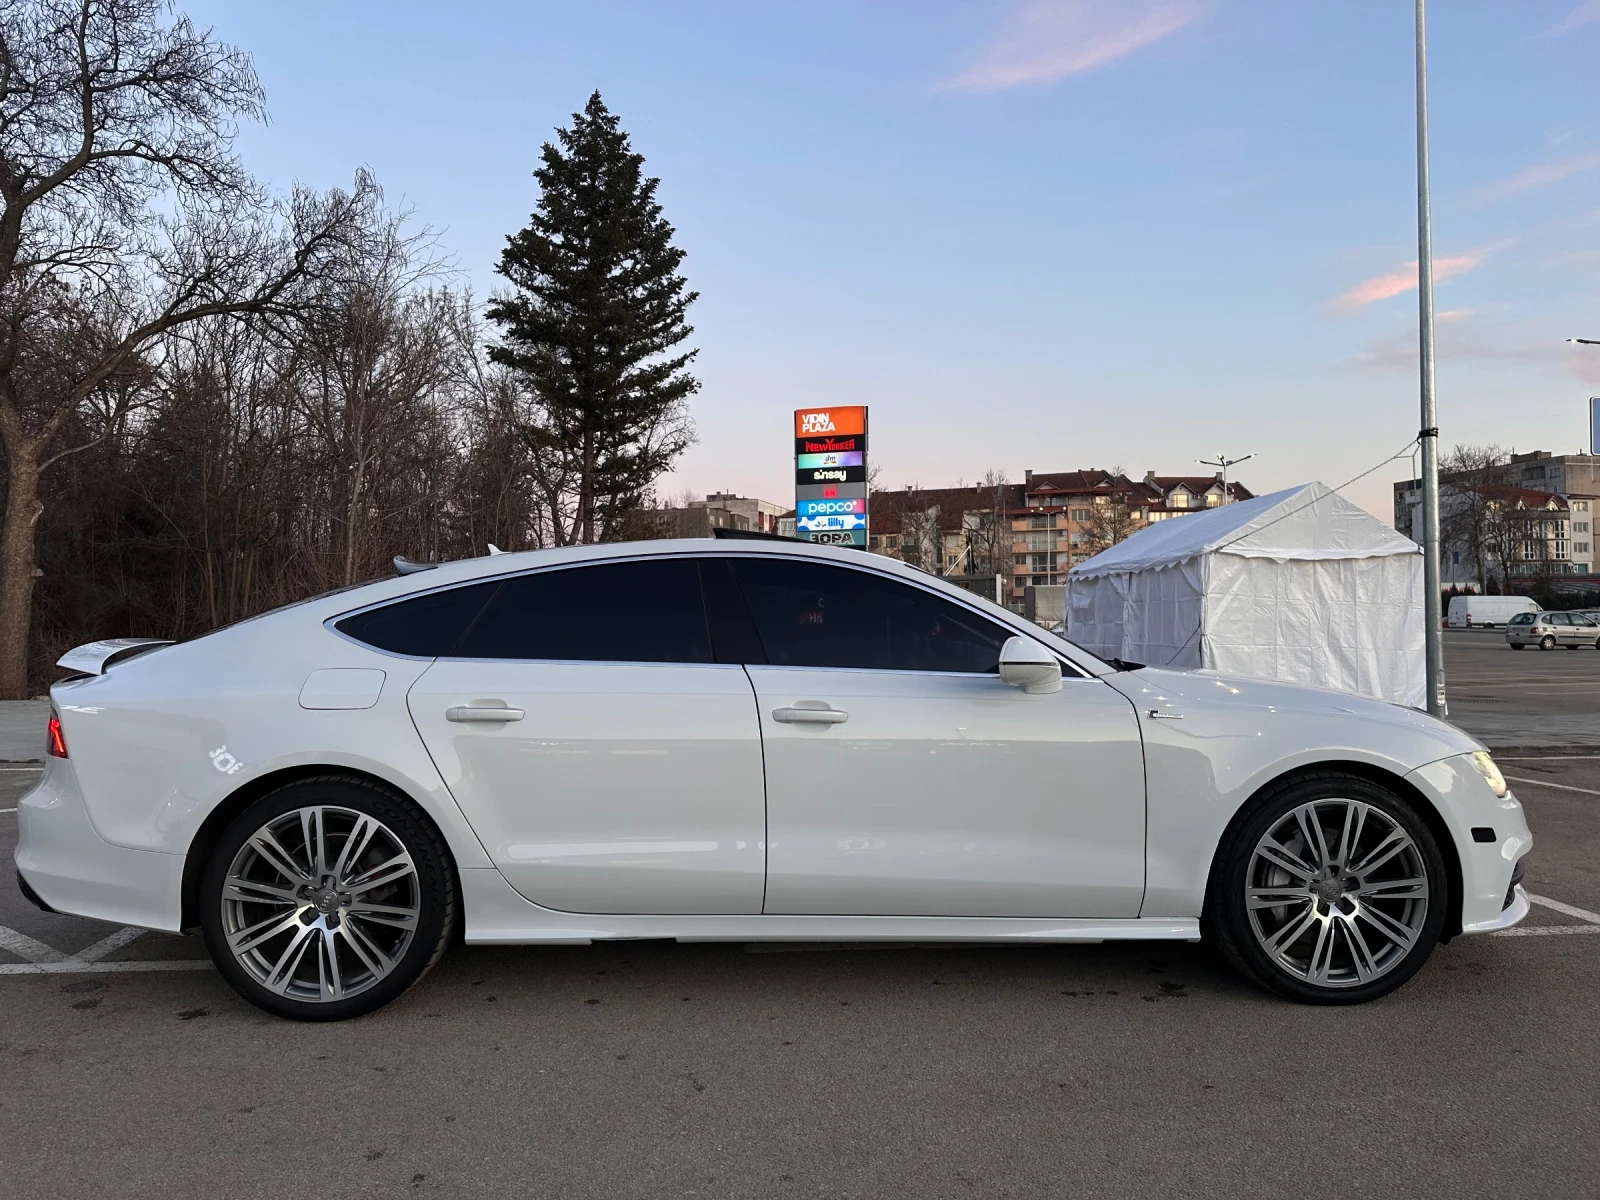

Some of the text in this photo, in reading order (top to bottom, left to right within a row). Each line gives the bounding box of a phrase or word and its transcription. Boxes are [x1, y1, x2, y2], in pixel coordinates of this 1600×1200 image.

[802, 413, 830, 424] VIDIN
[802, 422, 836, 433] PLAZA
[813, 469, 847, 481] sinsay
[808, 501, 854, 515] pepco
[828, 517, 844, 528] lilly
